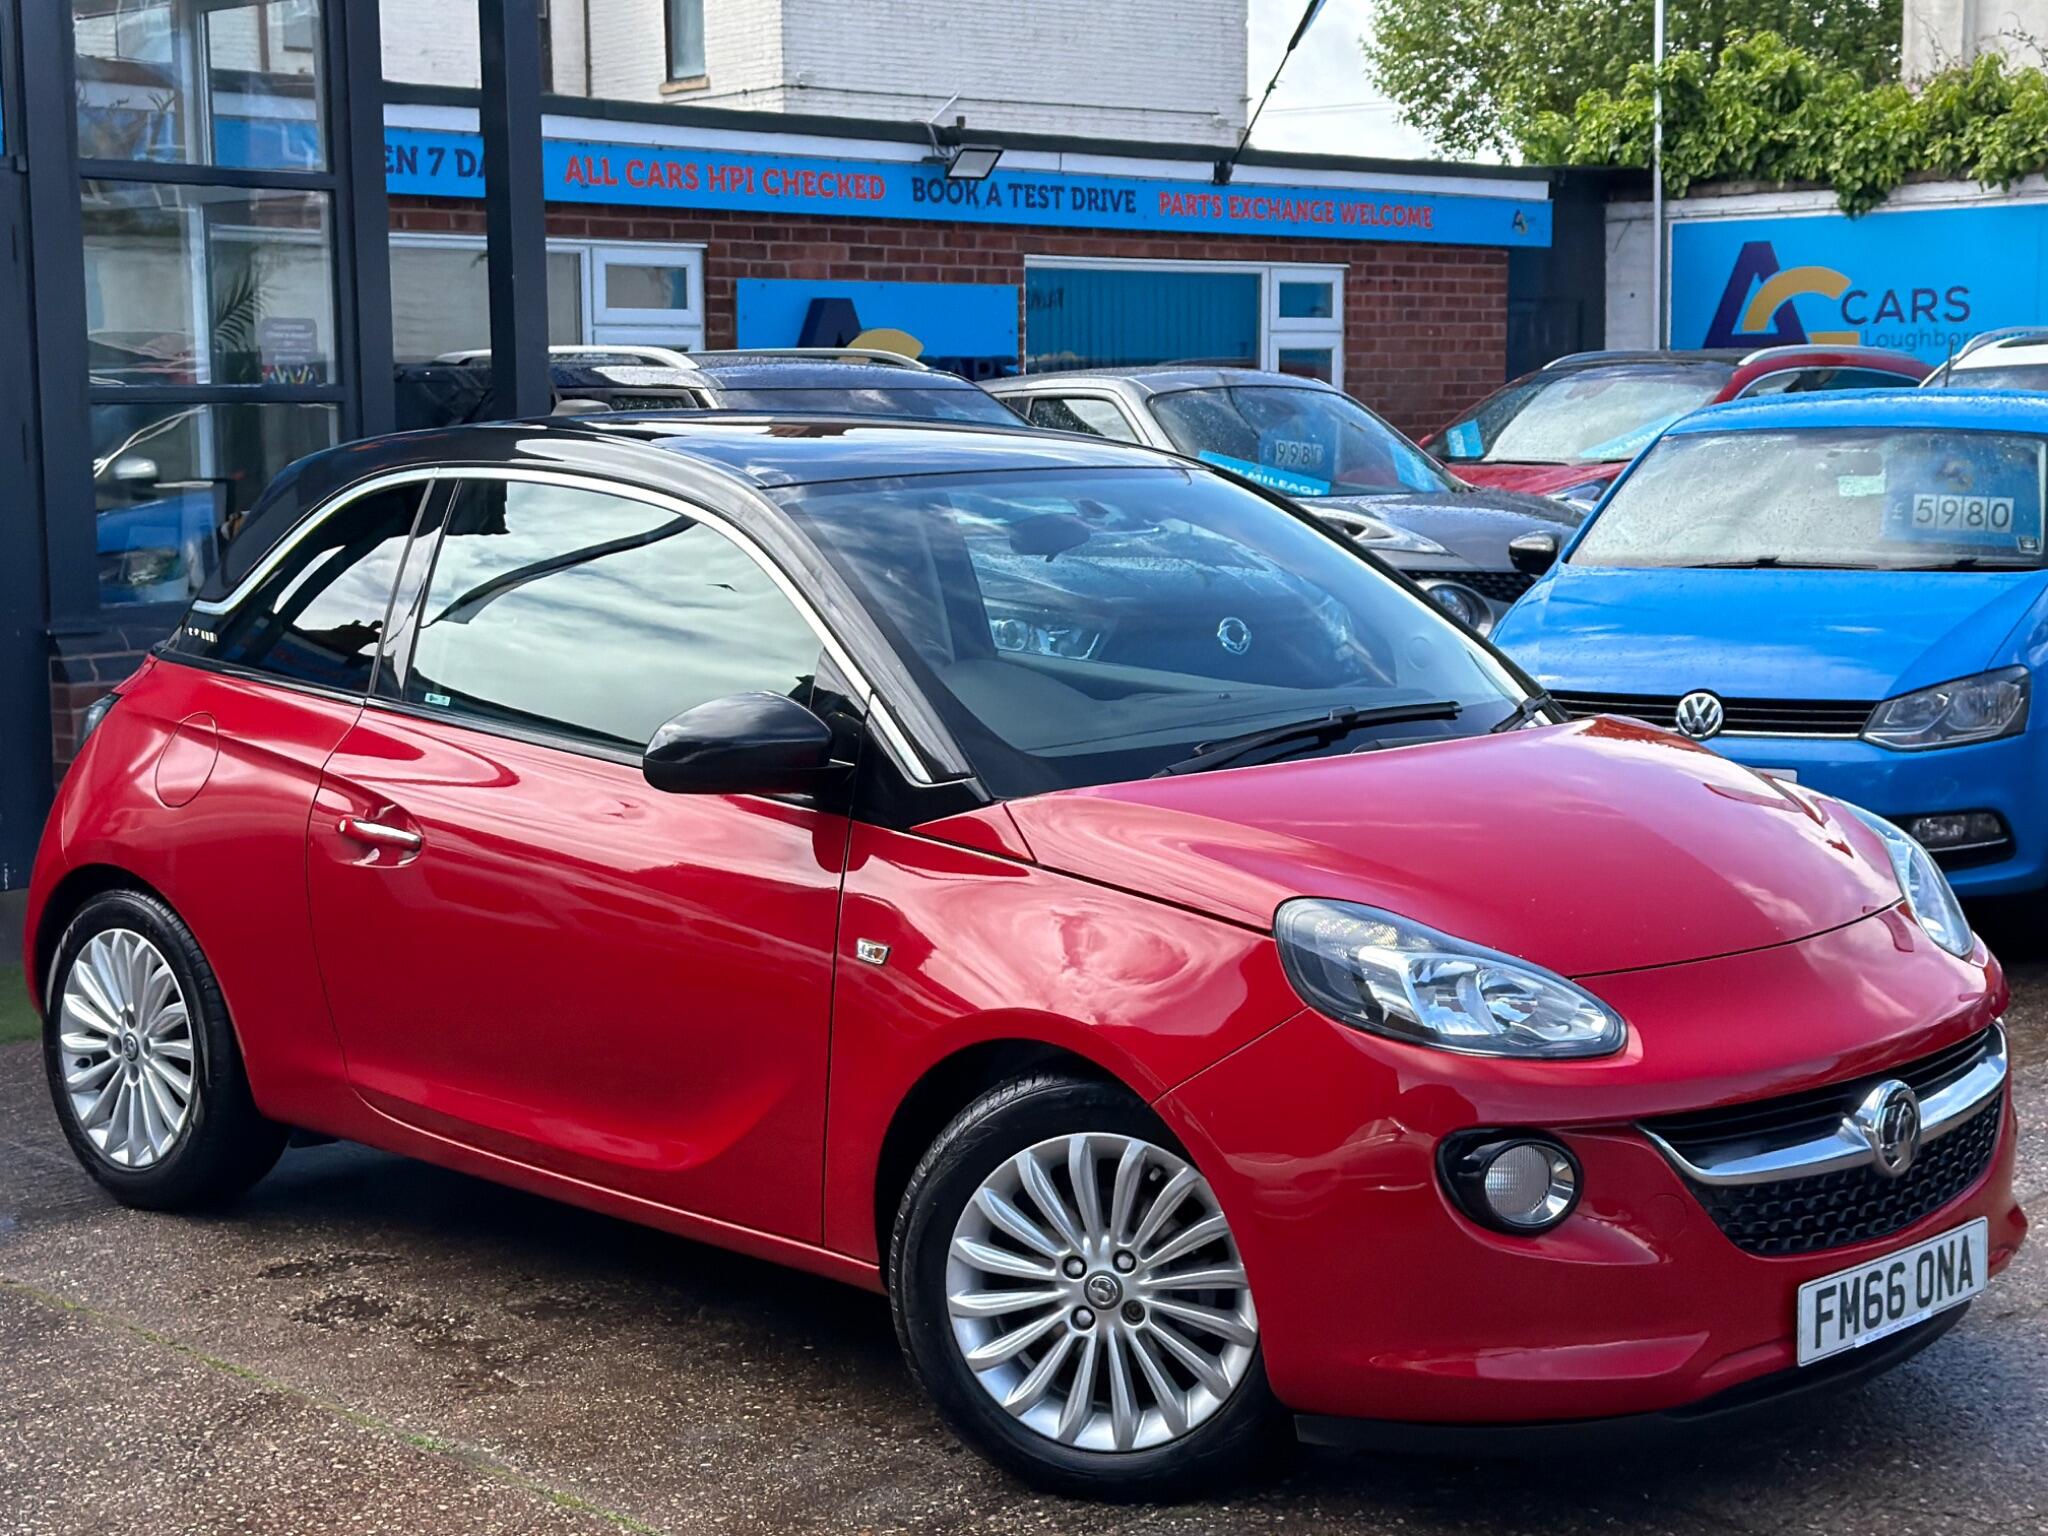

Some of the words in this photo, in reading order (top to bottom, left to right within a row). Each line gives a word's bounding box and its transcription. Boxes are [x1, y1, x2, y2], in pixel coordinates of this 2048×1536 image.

[427, 146, 446, 176] 7
[454, 148, 485, 178] D
[565, 155, 618, 186] ALL
[625, 159, 699, 190] CARS
[707, 164, 755, 194] HPI
[762, 168, 886, 200] CHECKED
[912, 177, 979, 205] BOOK
[986, 181, 1003, 207] A
[1008, 183, 1064, 209] TEST
[1071, 187, 1136, 213] DRIVE
[1159, 192, 1222, 218] PARTS
[1228, 196, 1334, 223] EXCHANGE
[1340, 202, 1433, 228] WELCOME
[1841, 286, 1971, 325] CARS
[1248, 471, 1323, 496] MILEAGE
[1915, 498, 2010, 529] 5980
[1814, 1262, 1906, 1350] FM66
[1915, 1235, 1974, 1310] ONA
